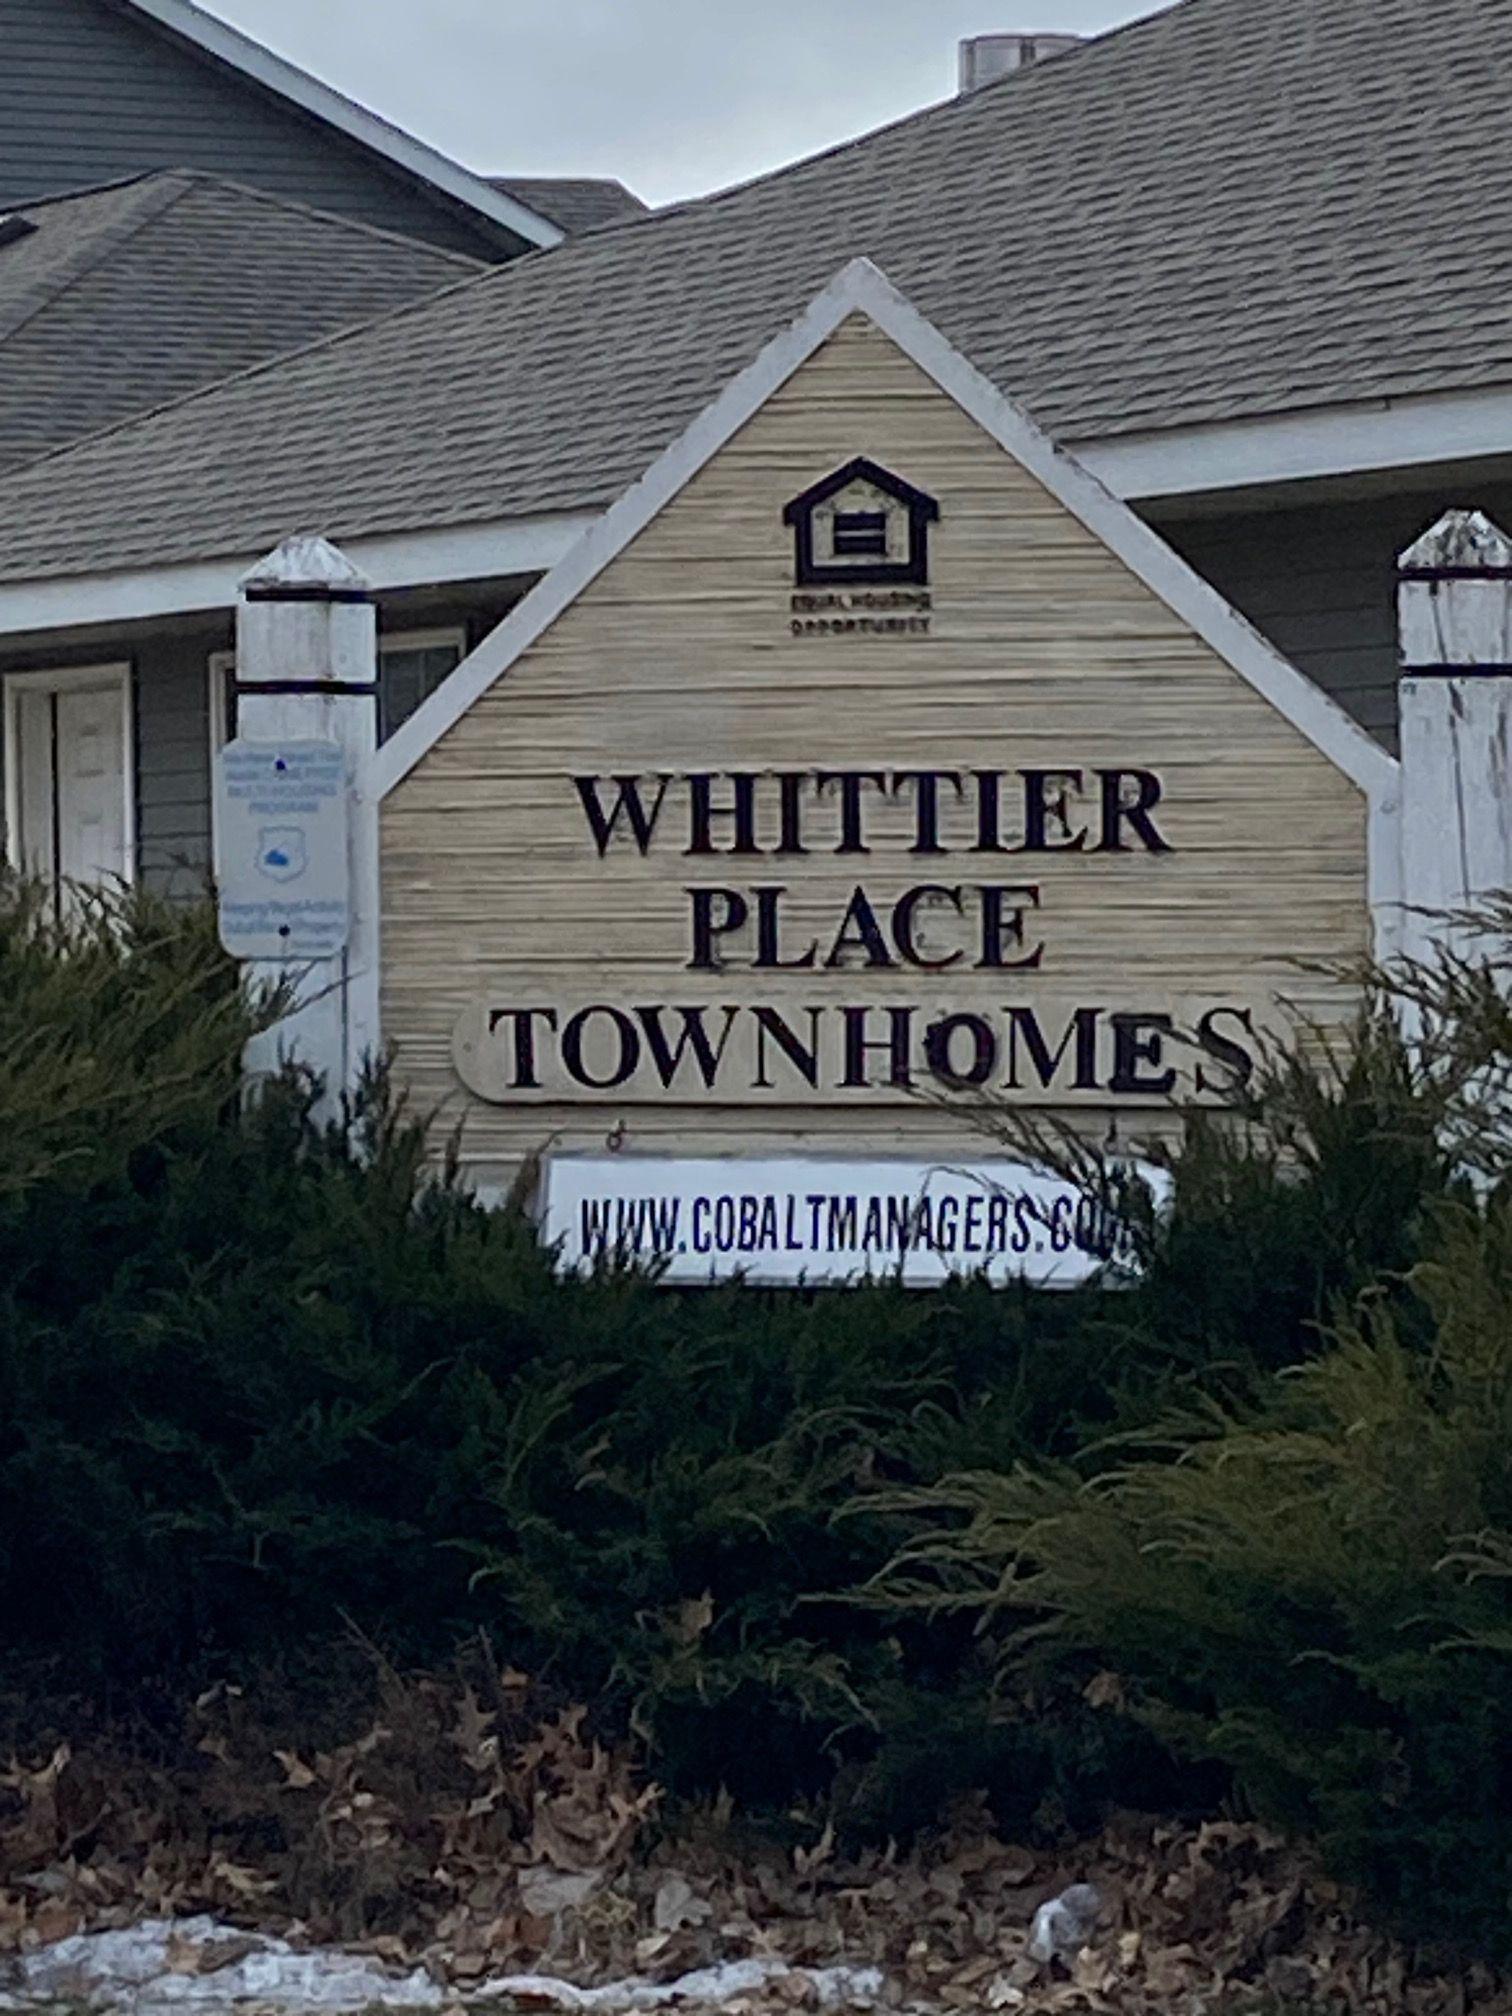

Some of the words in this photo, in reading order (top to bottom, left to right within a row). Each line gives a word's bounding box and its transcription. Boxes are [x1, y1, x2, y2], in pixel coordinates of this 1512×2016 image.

[574, 770, 1172, 857] WHITTIER
[685, 885, 1042, 971] PLACE
[490, 1005, 1256, 1093] TOWNHOMES
